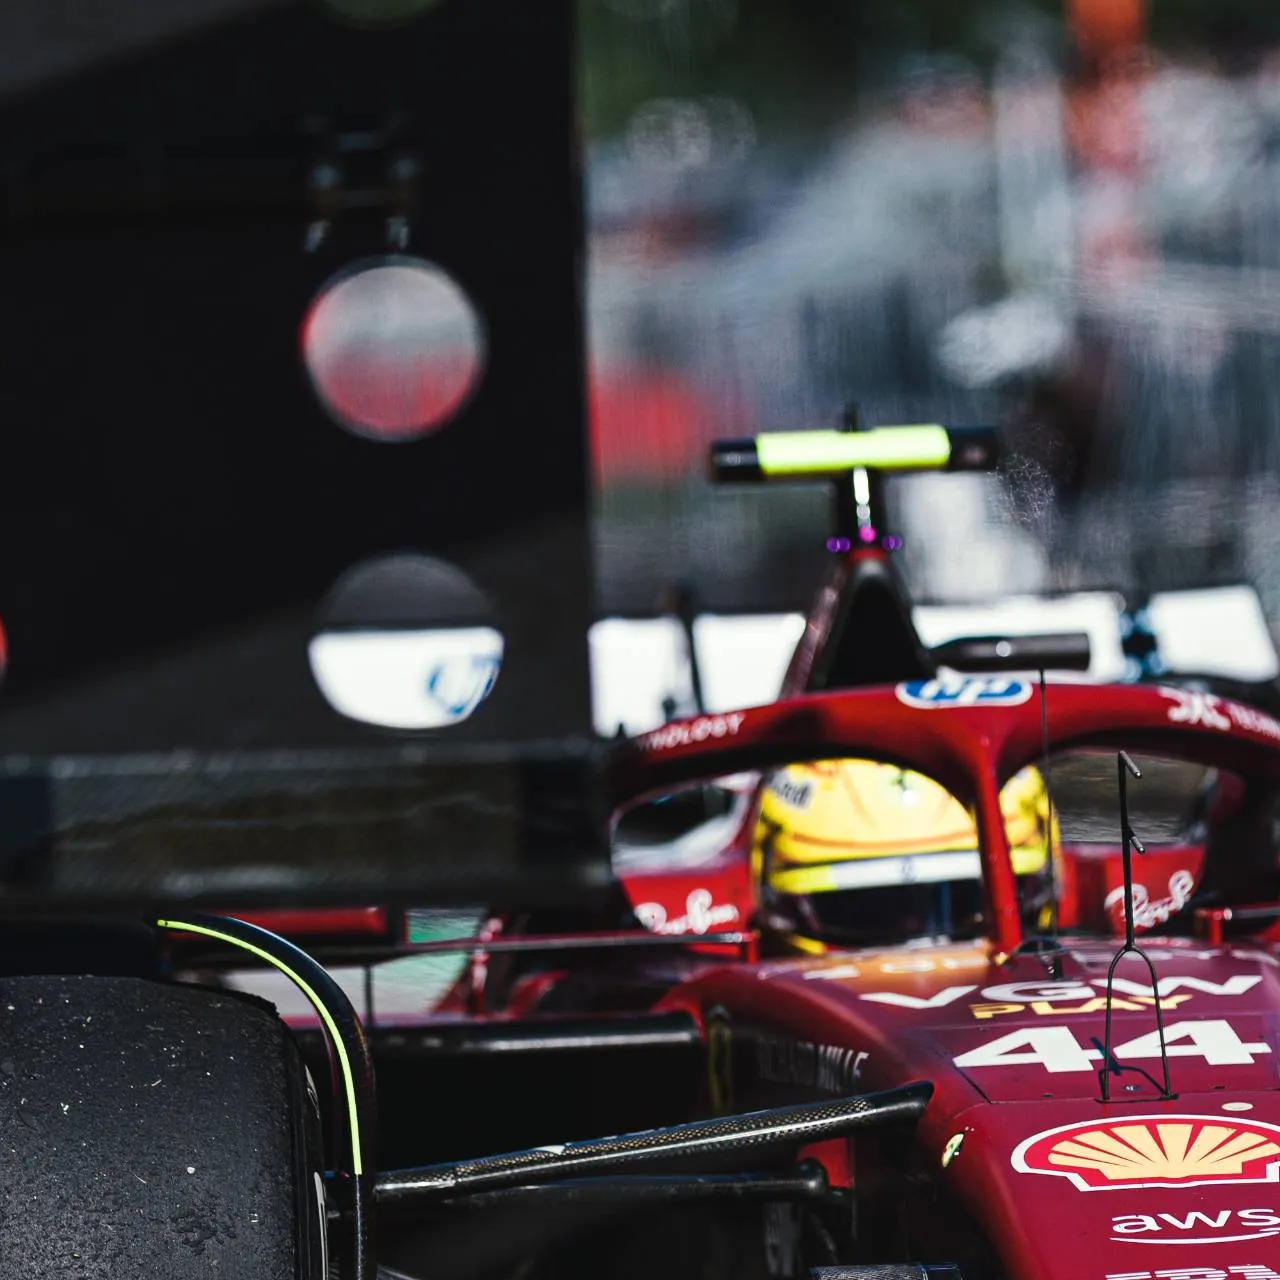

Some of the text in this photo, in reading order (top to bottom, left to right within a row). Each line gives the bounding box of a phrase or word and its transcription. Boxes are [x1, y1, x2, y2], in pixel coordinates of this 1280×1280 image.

[859, 974, 1263, 1010] VGW
[969, 994, 1194, 1020] PLAY
[953, 1019, 1271, 1073] 44
